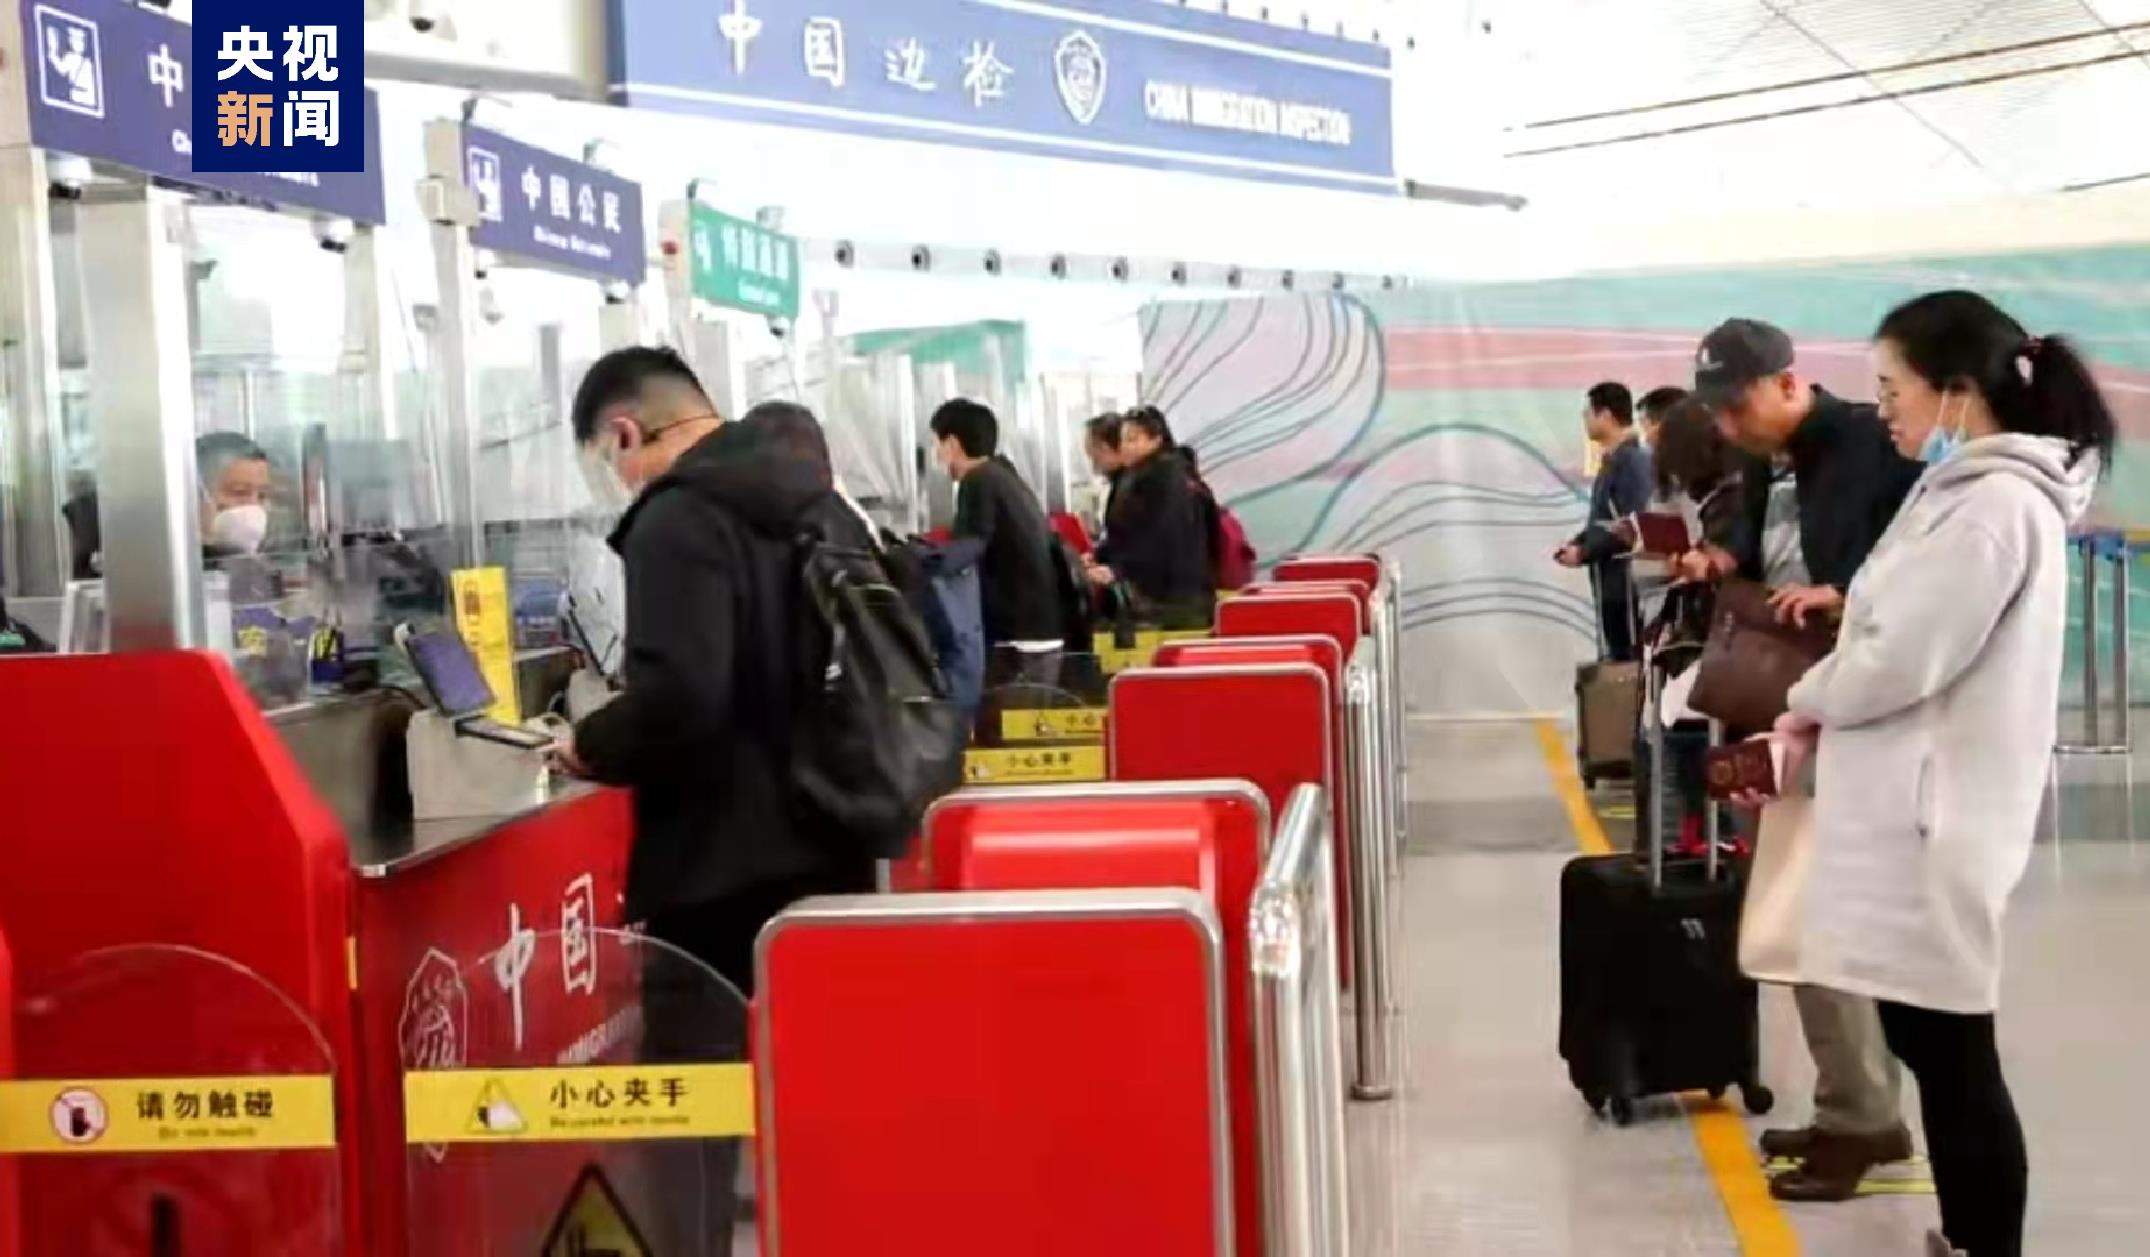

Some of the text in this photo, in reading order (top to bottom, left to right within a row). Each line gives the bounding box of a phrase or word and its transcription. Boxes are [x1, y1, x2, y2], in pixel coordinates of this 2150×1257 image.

[719, 0, 1014, 108] 中国边检
[137, 1090, 273, 1120] 请勿触碰
[550, 1077, 688, 1109] 小心夹手
